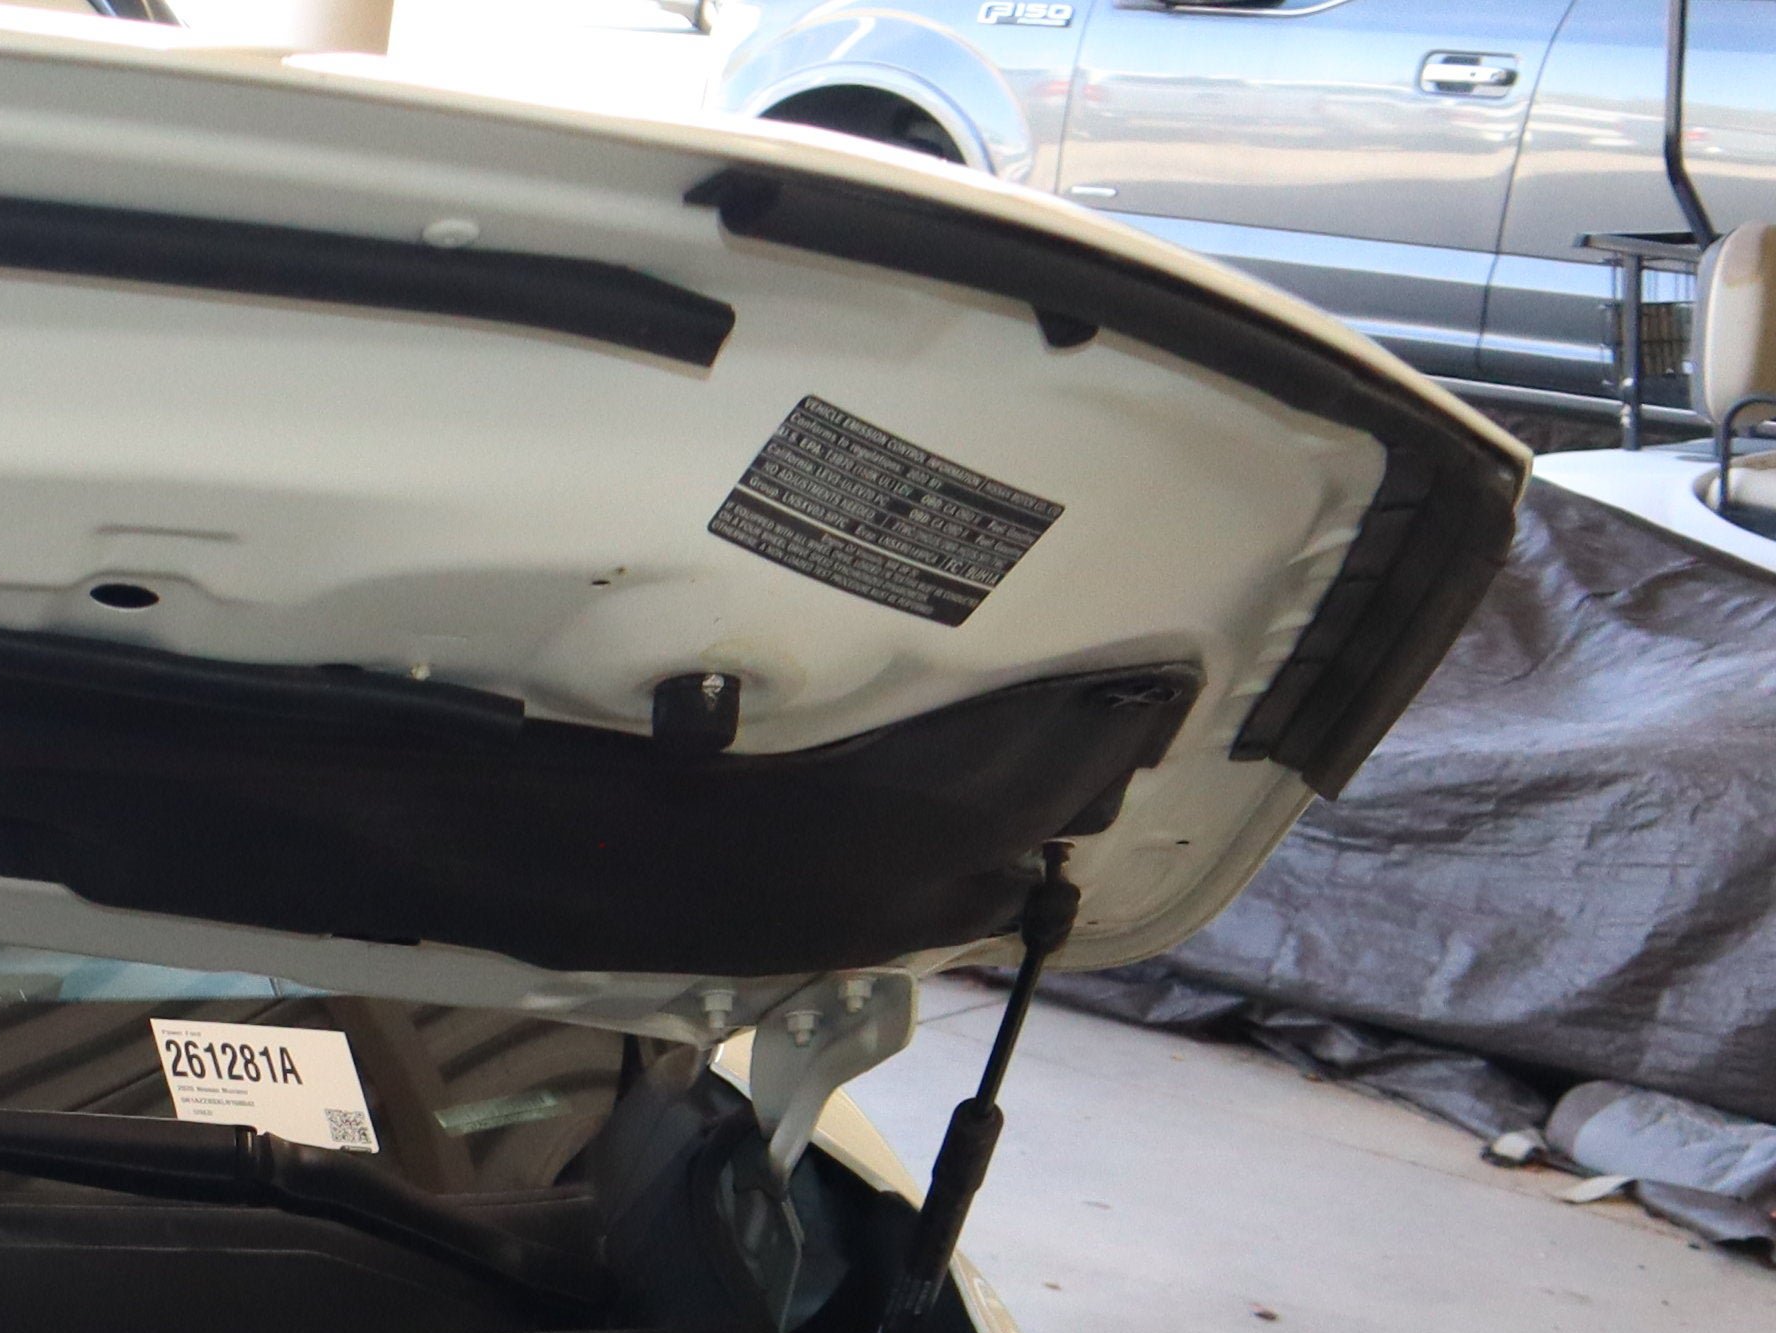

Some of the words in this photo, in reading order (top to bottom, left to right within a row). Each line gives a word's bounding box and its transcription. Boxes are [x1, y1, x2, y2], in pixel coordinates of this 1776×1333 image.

[976, 1, 1073, 24] F150
[789, 411, 840, 441] Conforms
[804, 398, 843, 423] VEHICLE
[842, 418, 887, 444] EMISSION
[887, 439, 925, 462] CONTROL
[927, 457, 980, 485] INFORMATION
[777, 469, 844, 504] ADJUSTMENTS
[840, 498, 875, 518] NEEDED
[165, 1039, 303, 1085] 261281A
